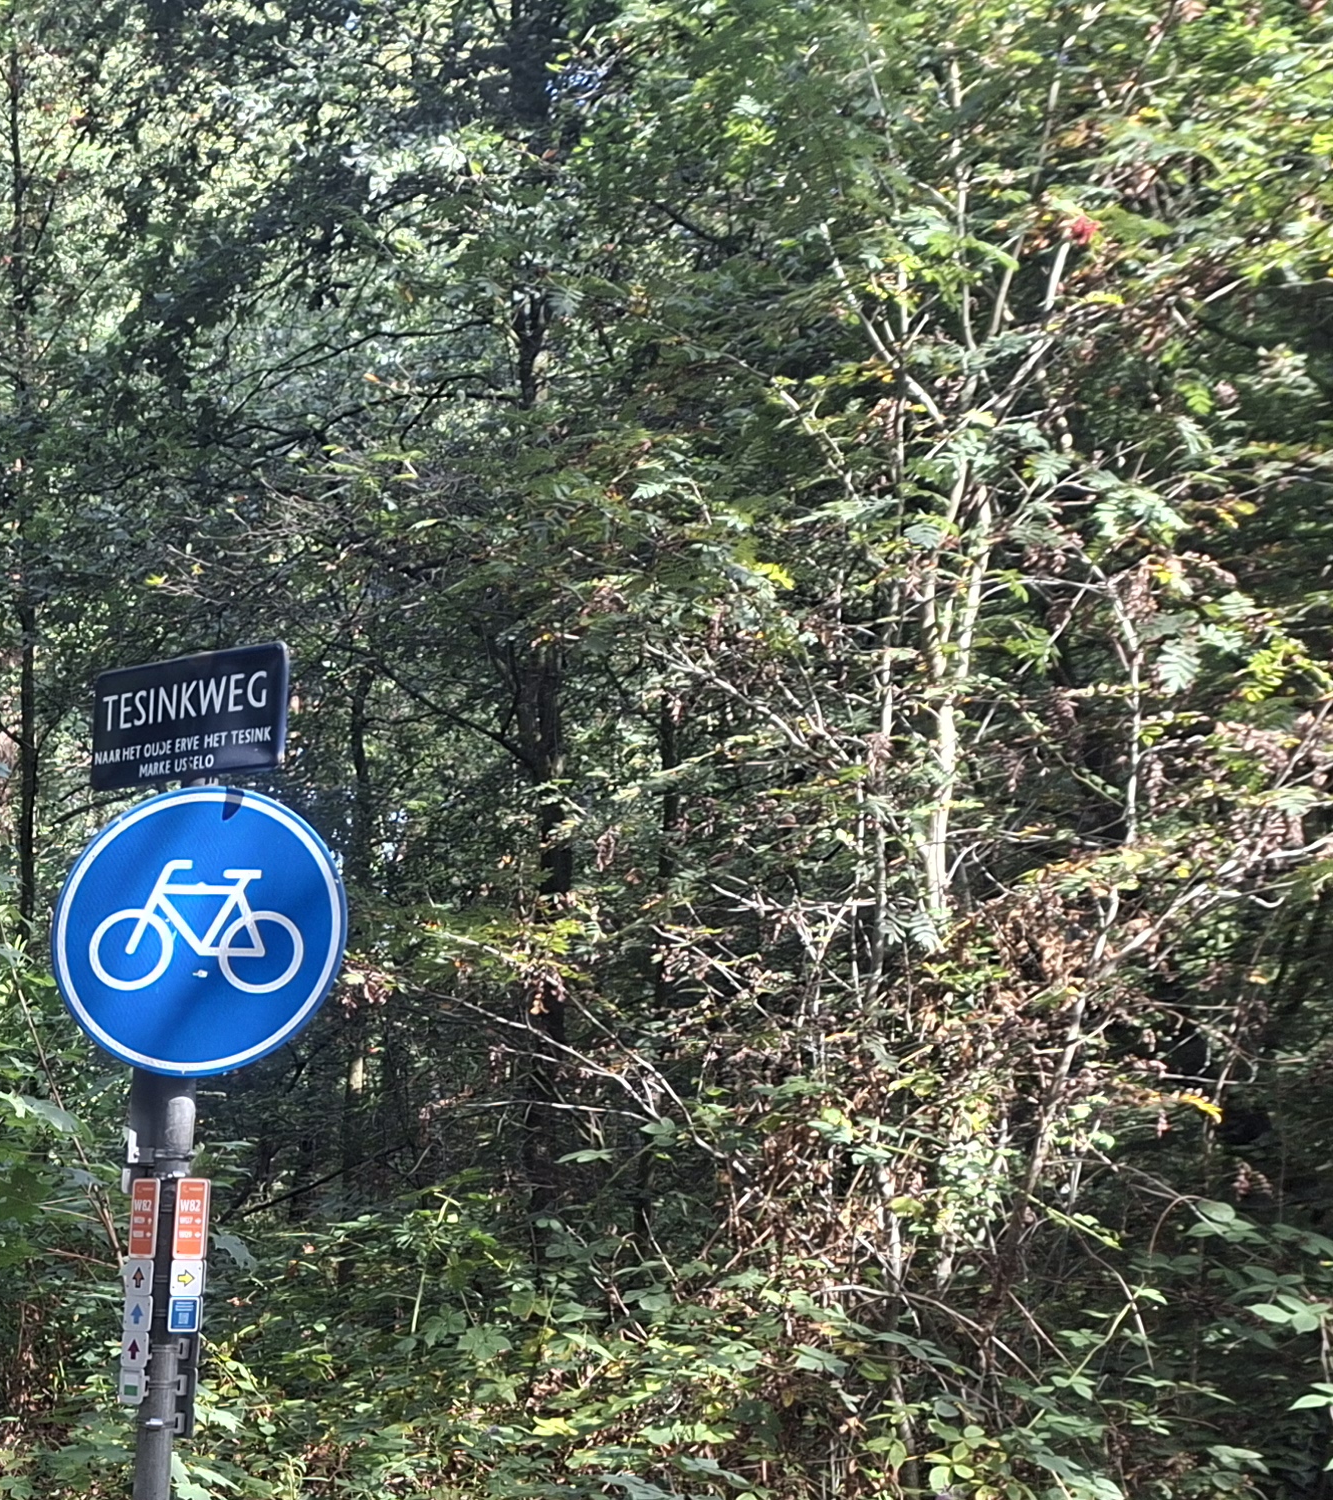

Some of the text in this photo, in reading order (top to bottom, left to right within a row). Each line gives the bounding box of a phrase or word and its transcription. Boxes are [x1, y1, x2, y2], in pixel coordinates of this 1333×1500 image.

[102, 671, 267, 731] TESINKWEG
[94, 726, 272, 765] NAAR HET OUDE ERVE HET TESINK
[139, 760, 171, 778] MARKE
[134, 1199, 151, 1211] W82
[180, 1199, 201, 1212] W82
